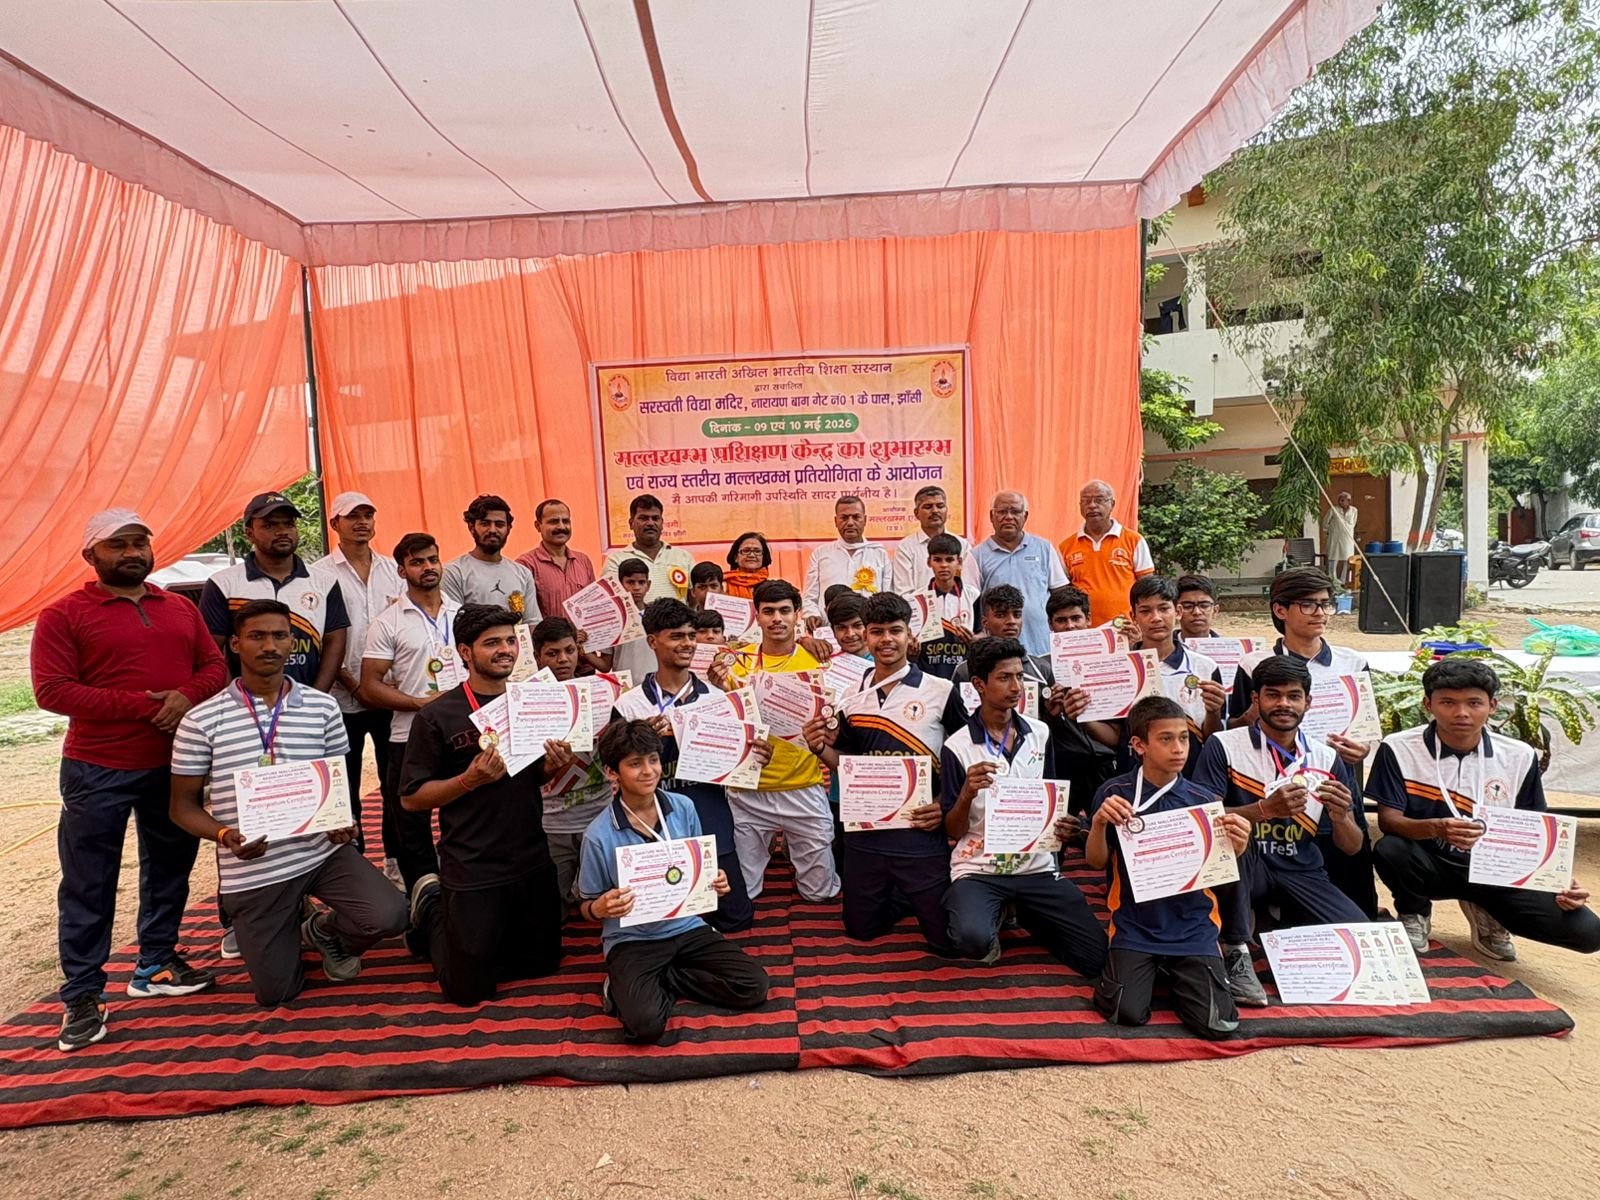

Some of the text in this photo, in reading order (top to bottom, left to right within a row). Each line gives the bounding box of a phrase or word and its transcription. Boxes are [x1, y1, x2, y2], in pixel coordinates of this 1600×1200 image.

[666, 361, 892, 382] विद्या भारती अखिल भारतीय शिक्षा संस्थान
[754, 383, 770, 392] द्वारा
[639, 395, 683, 414] सरस्वती
[686, 394, 711, 412] विद्या
[751, 396, 788, 409] नारायण
[791, 396, 809, 407] बाग
[812, 392, 828, 406] गेट
[858, 390, 869, 404] के
[709, 421, 742, 433] दिनांक
[754, 421, 767, 432] 09
[770, 418, 786, 431] एवं
[789, 421, 801, 431] 10
[804, 417, 822, 432] मई
[824, 419, 852, 430] 2026
[614, 438, 952, 468] मल्लखम्भ प्रशिक्षण केन्द्र का शुभारम्भ
[626, 461, 943, 490] एवं राज्य स्तरीय मल्लखम्भ प्रतियोगिता के आयोजन
[685, 491, 718, 504] आपकी
[765, 488, 808, 501] उपस्थिति
[811, 490, 837, 501] सादर
